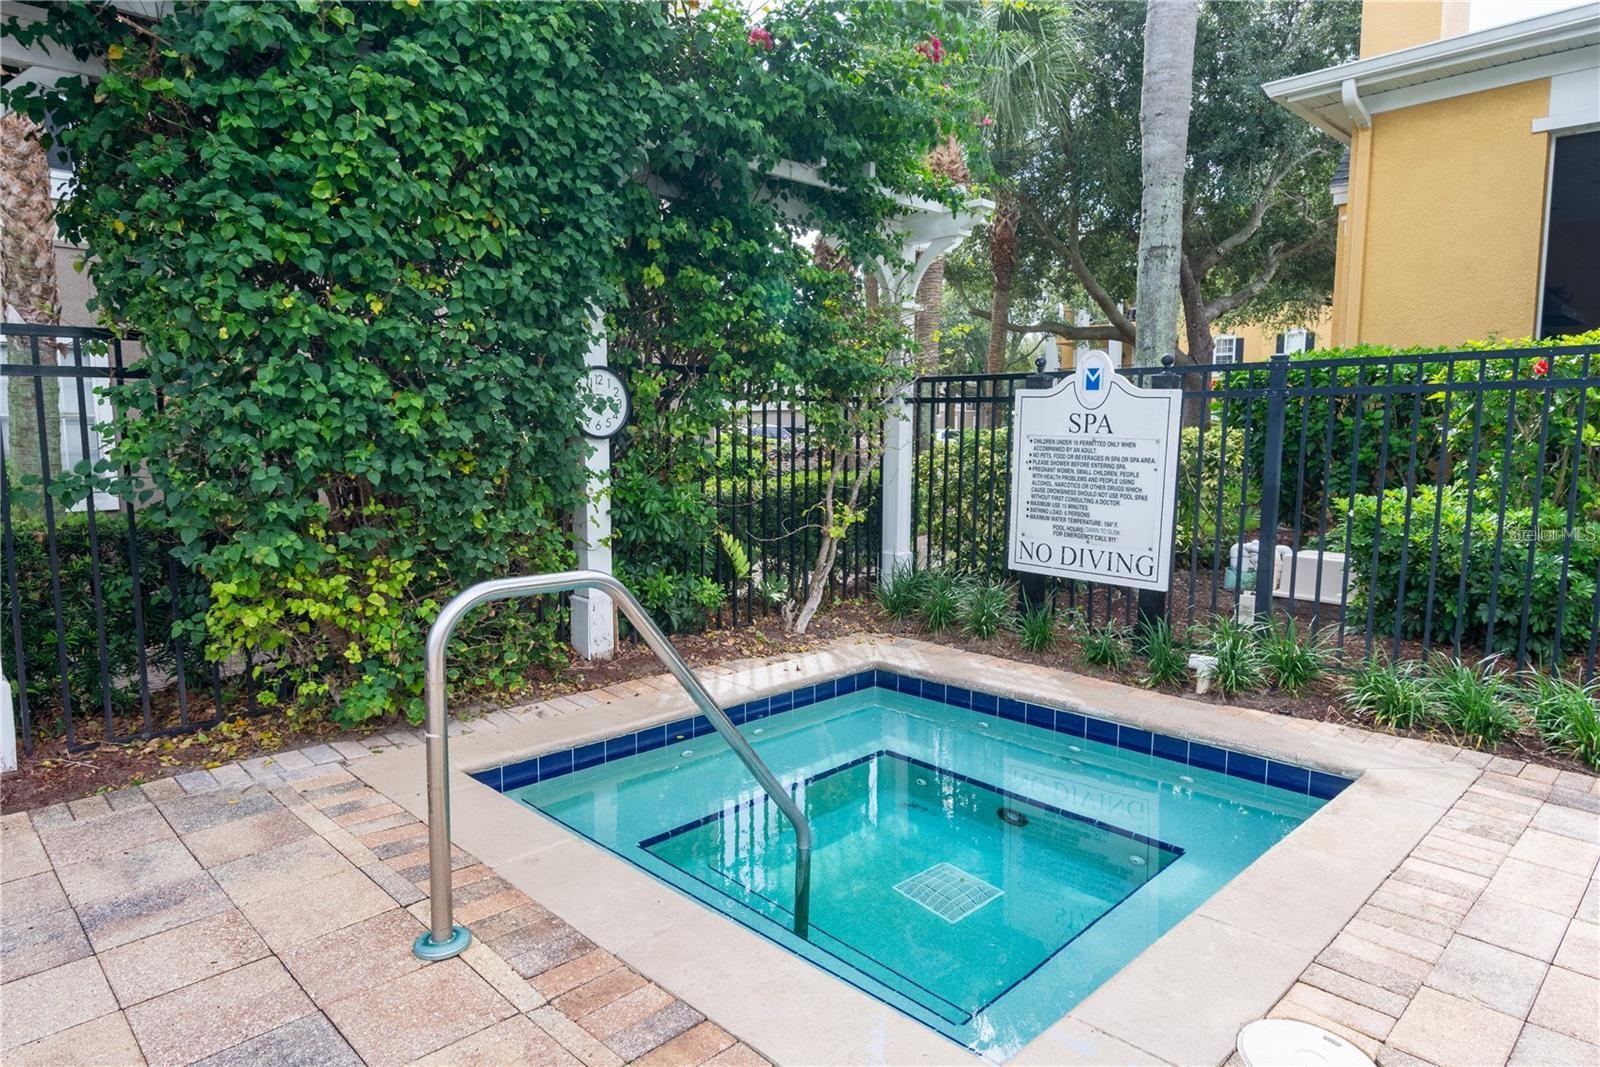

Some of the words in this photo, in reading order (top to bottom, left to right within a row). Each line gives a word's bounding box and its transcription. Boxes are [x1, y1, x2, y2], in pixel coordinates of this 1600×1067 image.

[594, 374, 603, 385] 12
[608, 379, 611, 388] 1
[613, 387, 619, 397] 2
[616, 399, 622, 408] 3
[595, 420, 602, 431] 6
[605, 418, 611, 428] 5
[1068, 412, 1112, 434] SPA
[1068, 517, 1103, 526] TEMPERATURE:
[1019, 540, 1052, 562] NO
[1060, 546, 1154, 578] DIVING
